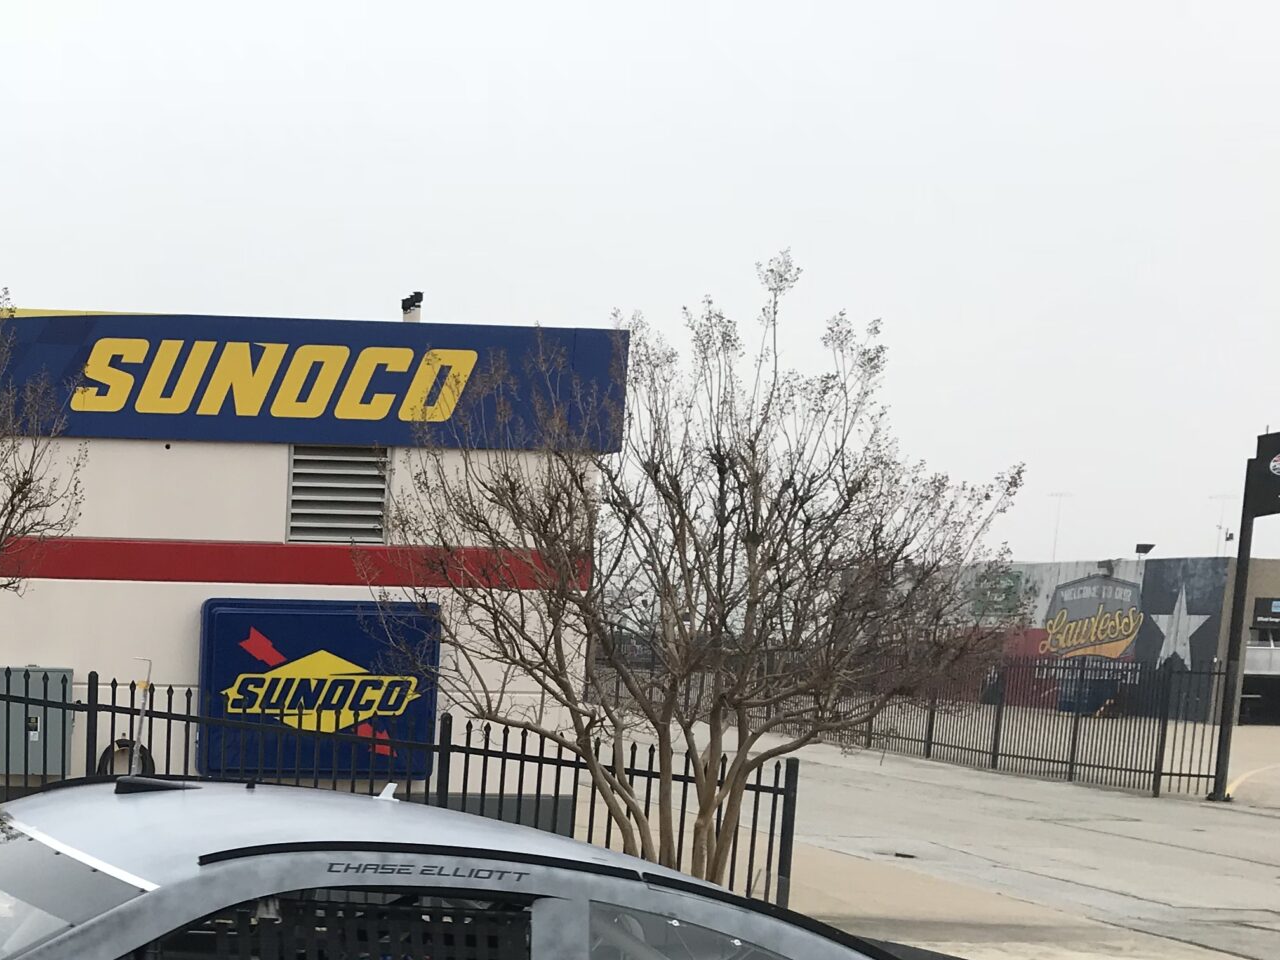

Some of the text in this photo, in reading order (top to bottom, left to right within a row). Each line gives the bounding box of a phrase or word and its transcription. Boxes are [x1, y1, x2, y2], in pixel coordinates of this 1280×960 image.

[70, 337, 478, 422] SUNOCO
[1039, 603, 1141, 655] Lawless
[230, 677, 413, 712] SUNOCO
[326, 862, 531, 882] CHASE ELLIOTT
